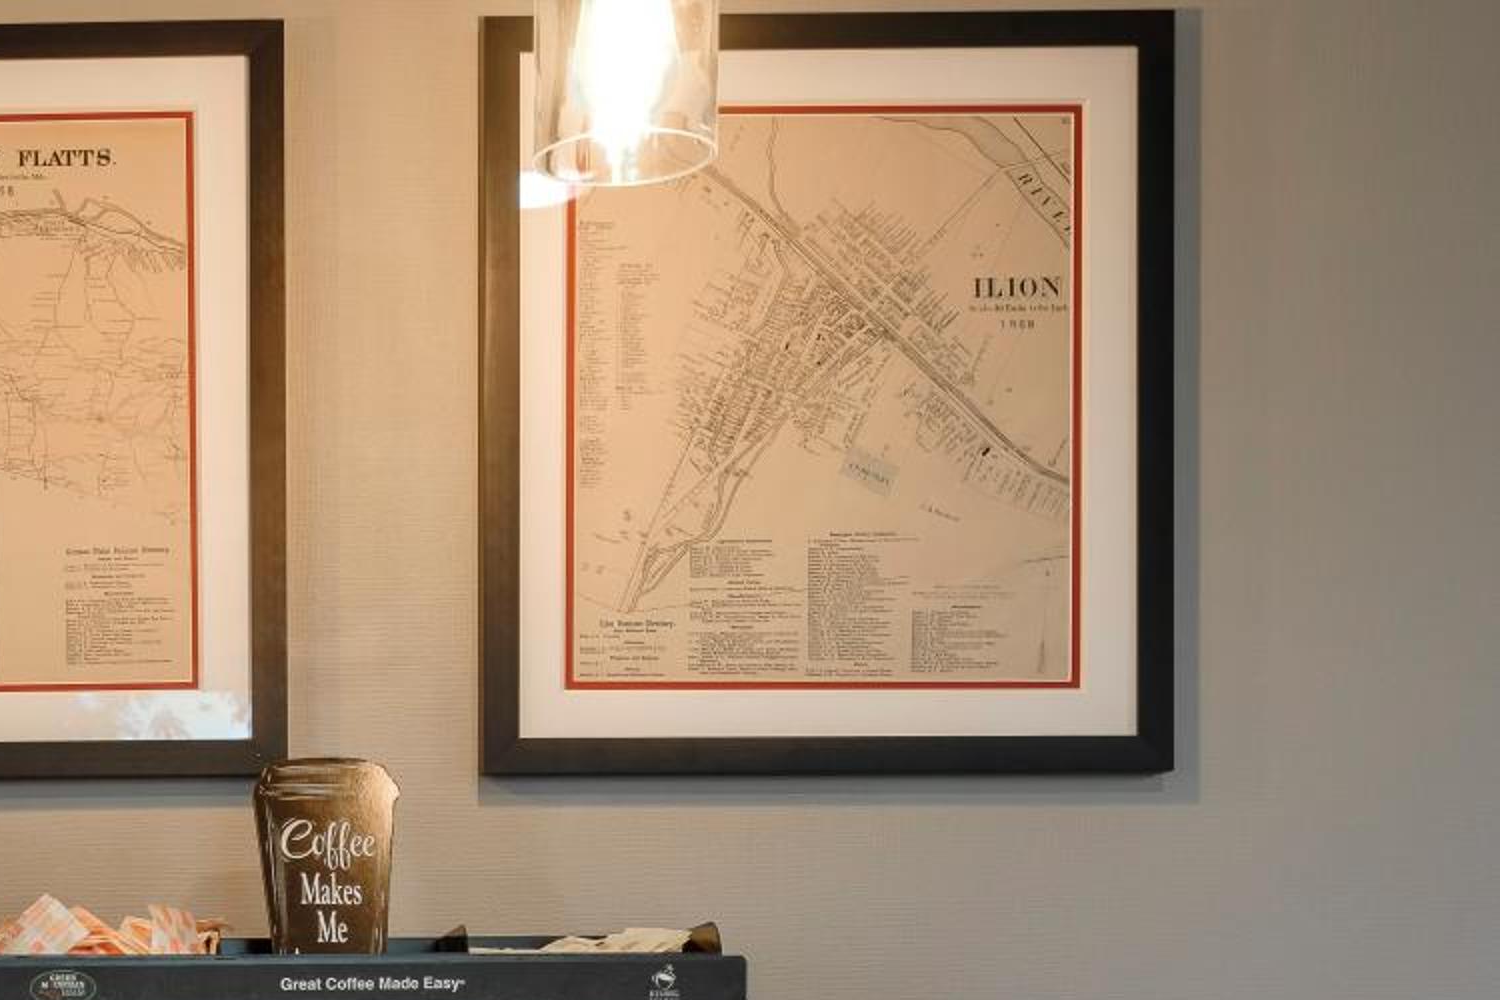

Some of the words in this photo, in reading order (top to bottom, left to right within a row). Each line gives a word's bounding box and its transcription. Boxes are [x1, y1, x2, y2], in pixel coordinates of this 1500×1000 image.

[18, 148, 117, 167] FLATTS.
[974, 276, 1061, 299] ILION
[281, 819, 375, 870] Coffee
[301, 872, 363, 905] Makes
[317, 910, 349, 943] Me
[280, 977, 322, 991] Great
[325, 976, 375, 991] Coffee
[379, 976, 419, 990] Made
